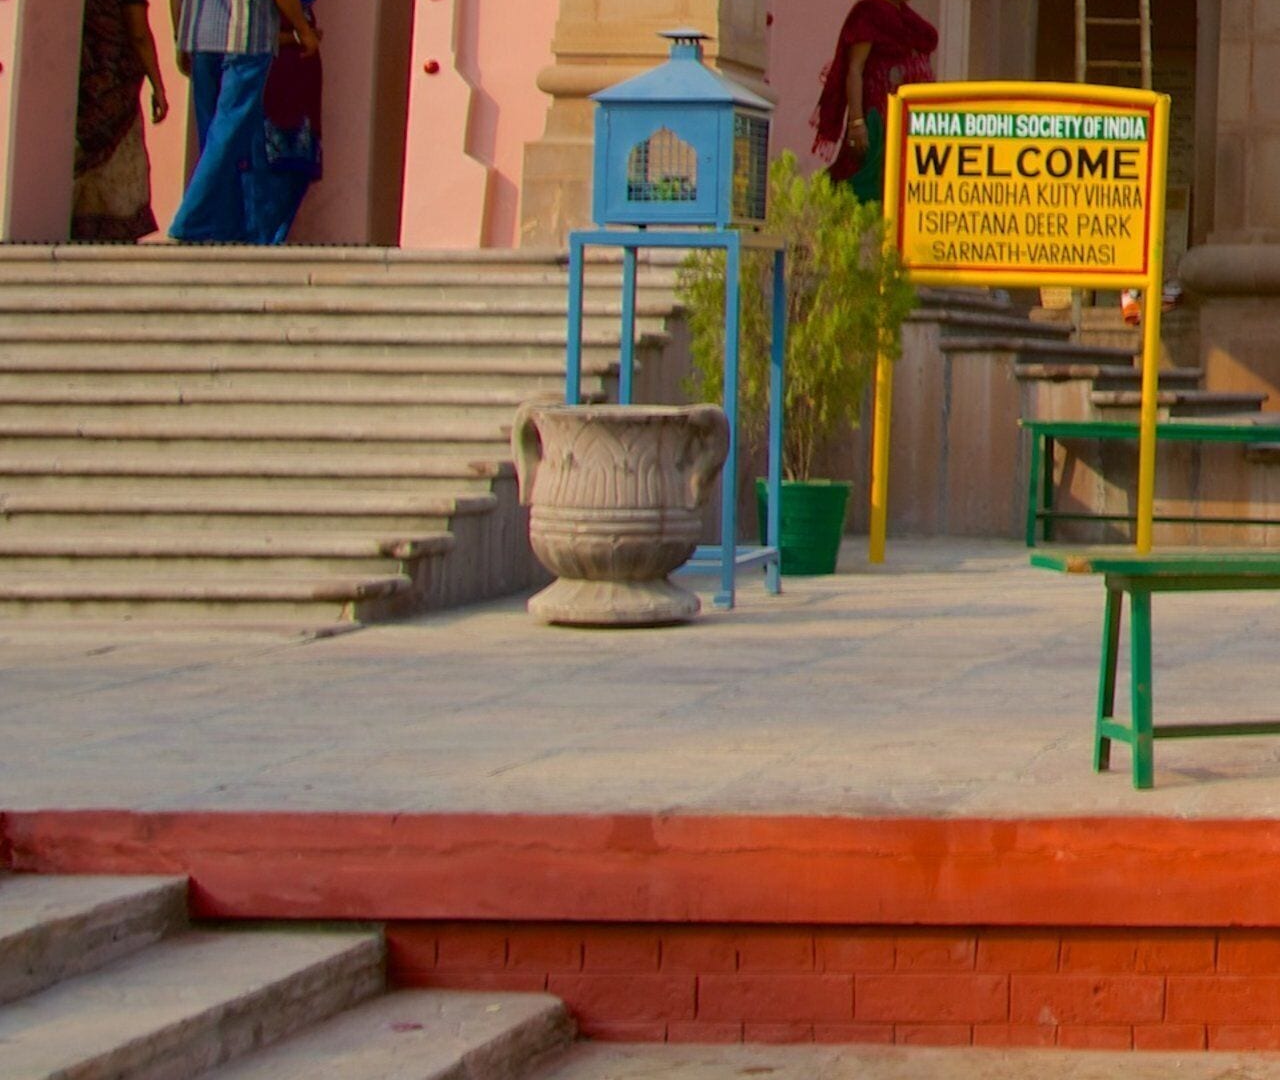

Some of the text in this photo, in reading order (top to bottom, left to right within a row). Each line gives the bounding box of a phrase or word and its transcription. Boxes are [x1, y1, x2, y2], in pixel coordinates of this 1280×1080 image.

[910, 112, 1146, 140] MAHA BODHI SOCIETY OF INDIA
[914, 144, 1140, 180] WELCOME
[907, 181, 1142, 209] MULA GANDHA KUTY VIHARA
[918, 210, 1131, 238] ISIPATANA DEER PARK
[932, 243, 1116, 265] SARNATH-VARANASI
